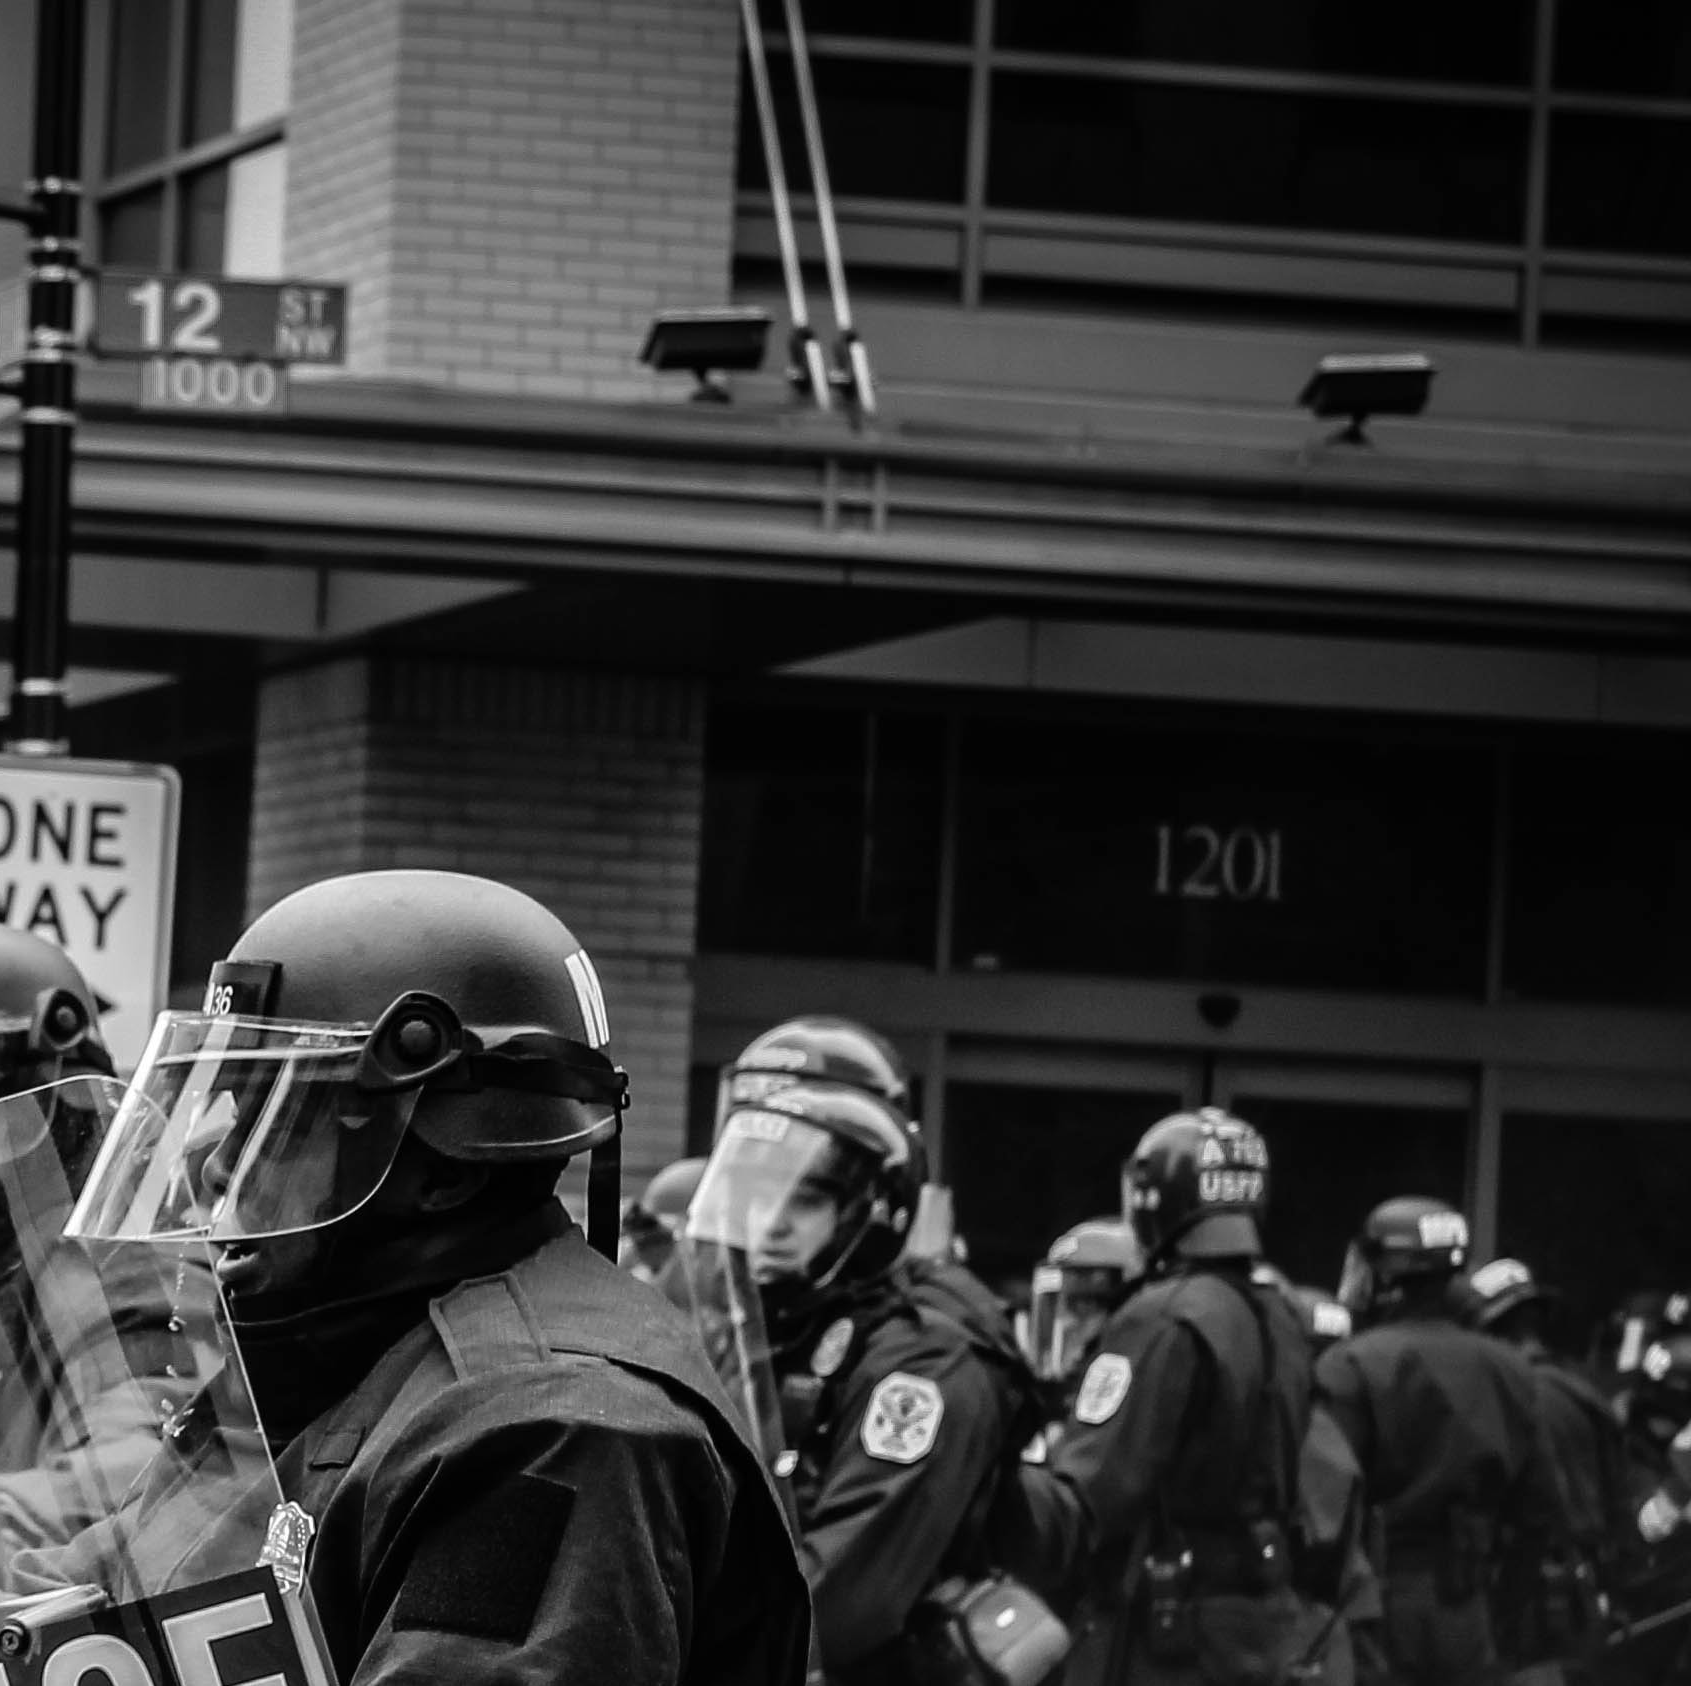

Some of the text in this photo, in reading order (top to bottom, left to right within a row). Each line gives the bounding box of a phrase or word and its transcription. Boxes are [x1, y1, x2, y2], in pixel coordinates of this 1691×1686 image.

[130, 278, 220, 350] 12
[279, 287, 329, 323] ST
[148, 358, 276, 404] 1000
[1155, 823, 1281, 900] 1201
